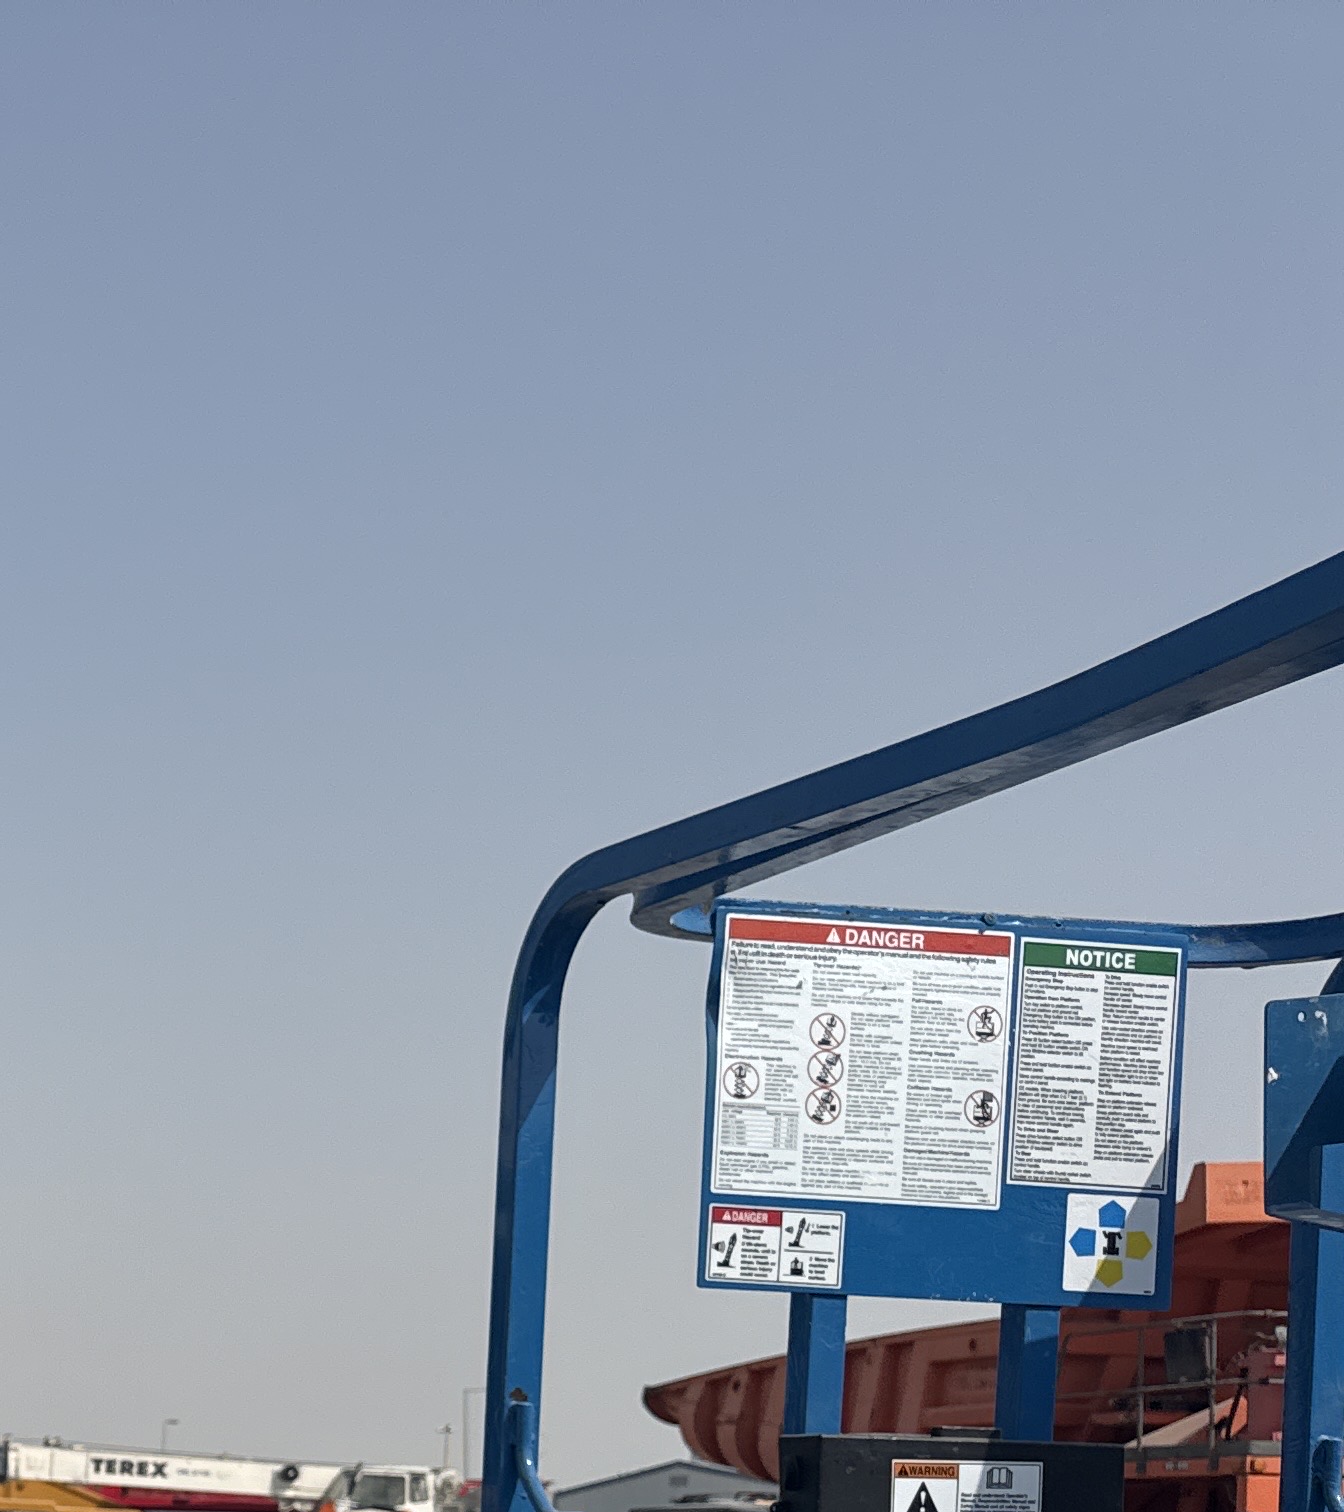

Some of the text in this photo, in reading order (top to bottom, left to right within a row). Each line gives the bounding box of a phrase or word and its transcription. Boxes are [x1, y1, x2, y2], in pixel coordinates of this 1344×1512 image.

[845, 928, 925, 950] DANGER
[1066, 948, 1136, 970] NOTICE
[732, 1210, 769, 1224] DANGER
[91, 1458, 167, 1478] TEREX
[909, 1465, 955, 1477] WARNING
